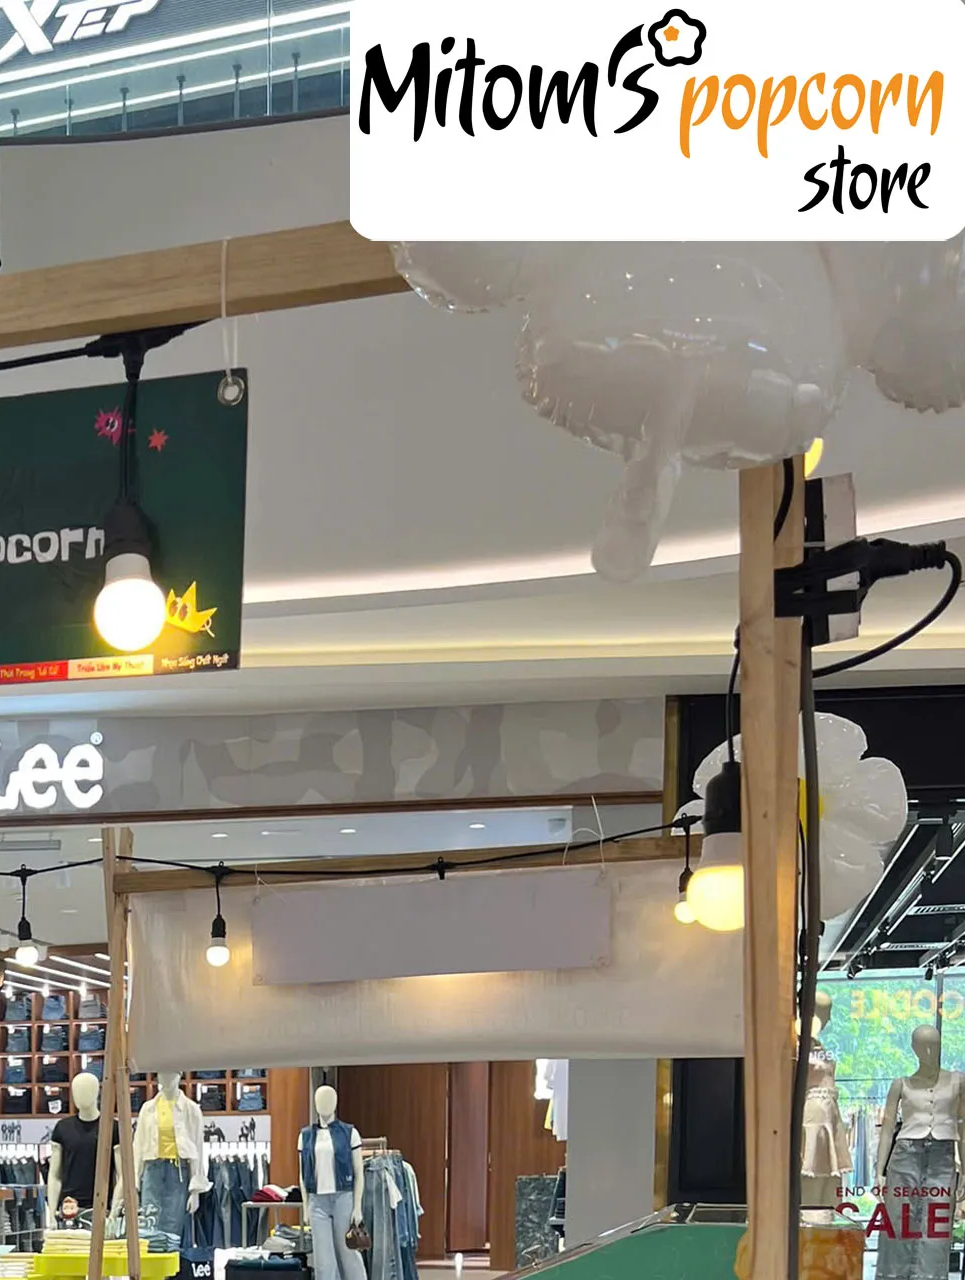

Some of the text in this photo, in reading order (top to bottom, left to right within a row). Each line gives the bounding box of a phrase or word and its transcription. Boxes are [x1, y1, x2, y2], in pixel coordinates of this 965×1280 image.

[836, 1186, 951, 1198] END OF SEASON
[192, 1262, 211, 1278] Lee
